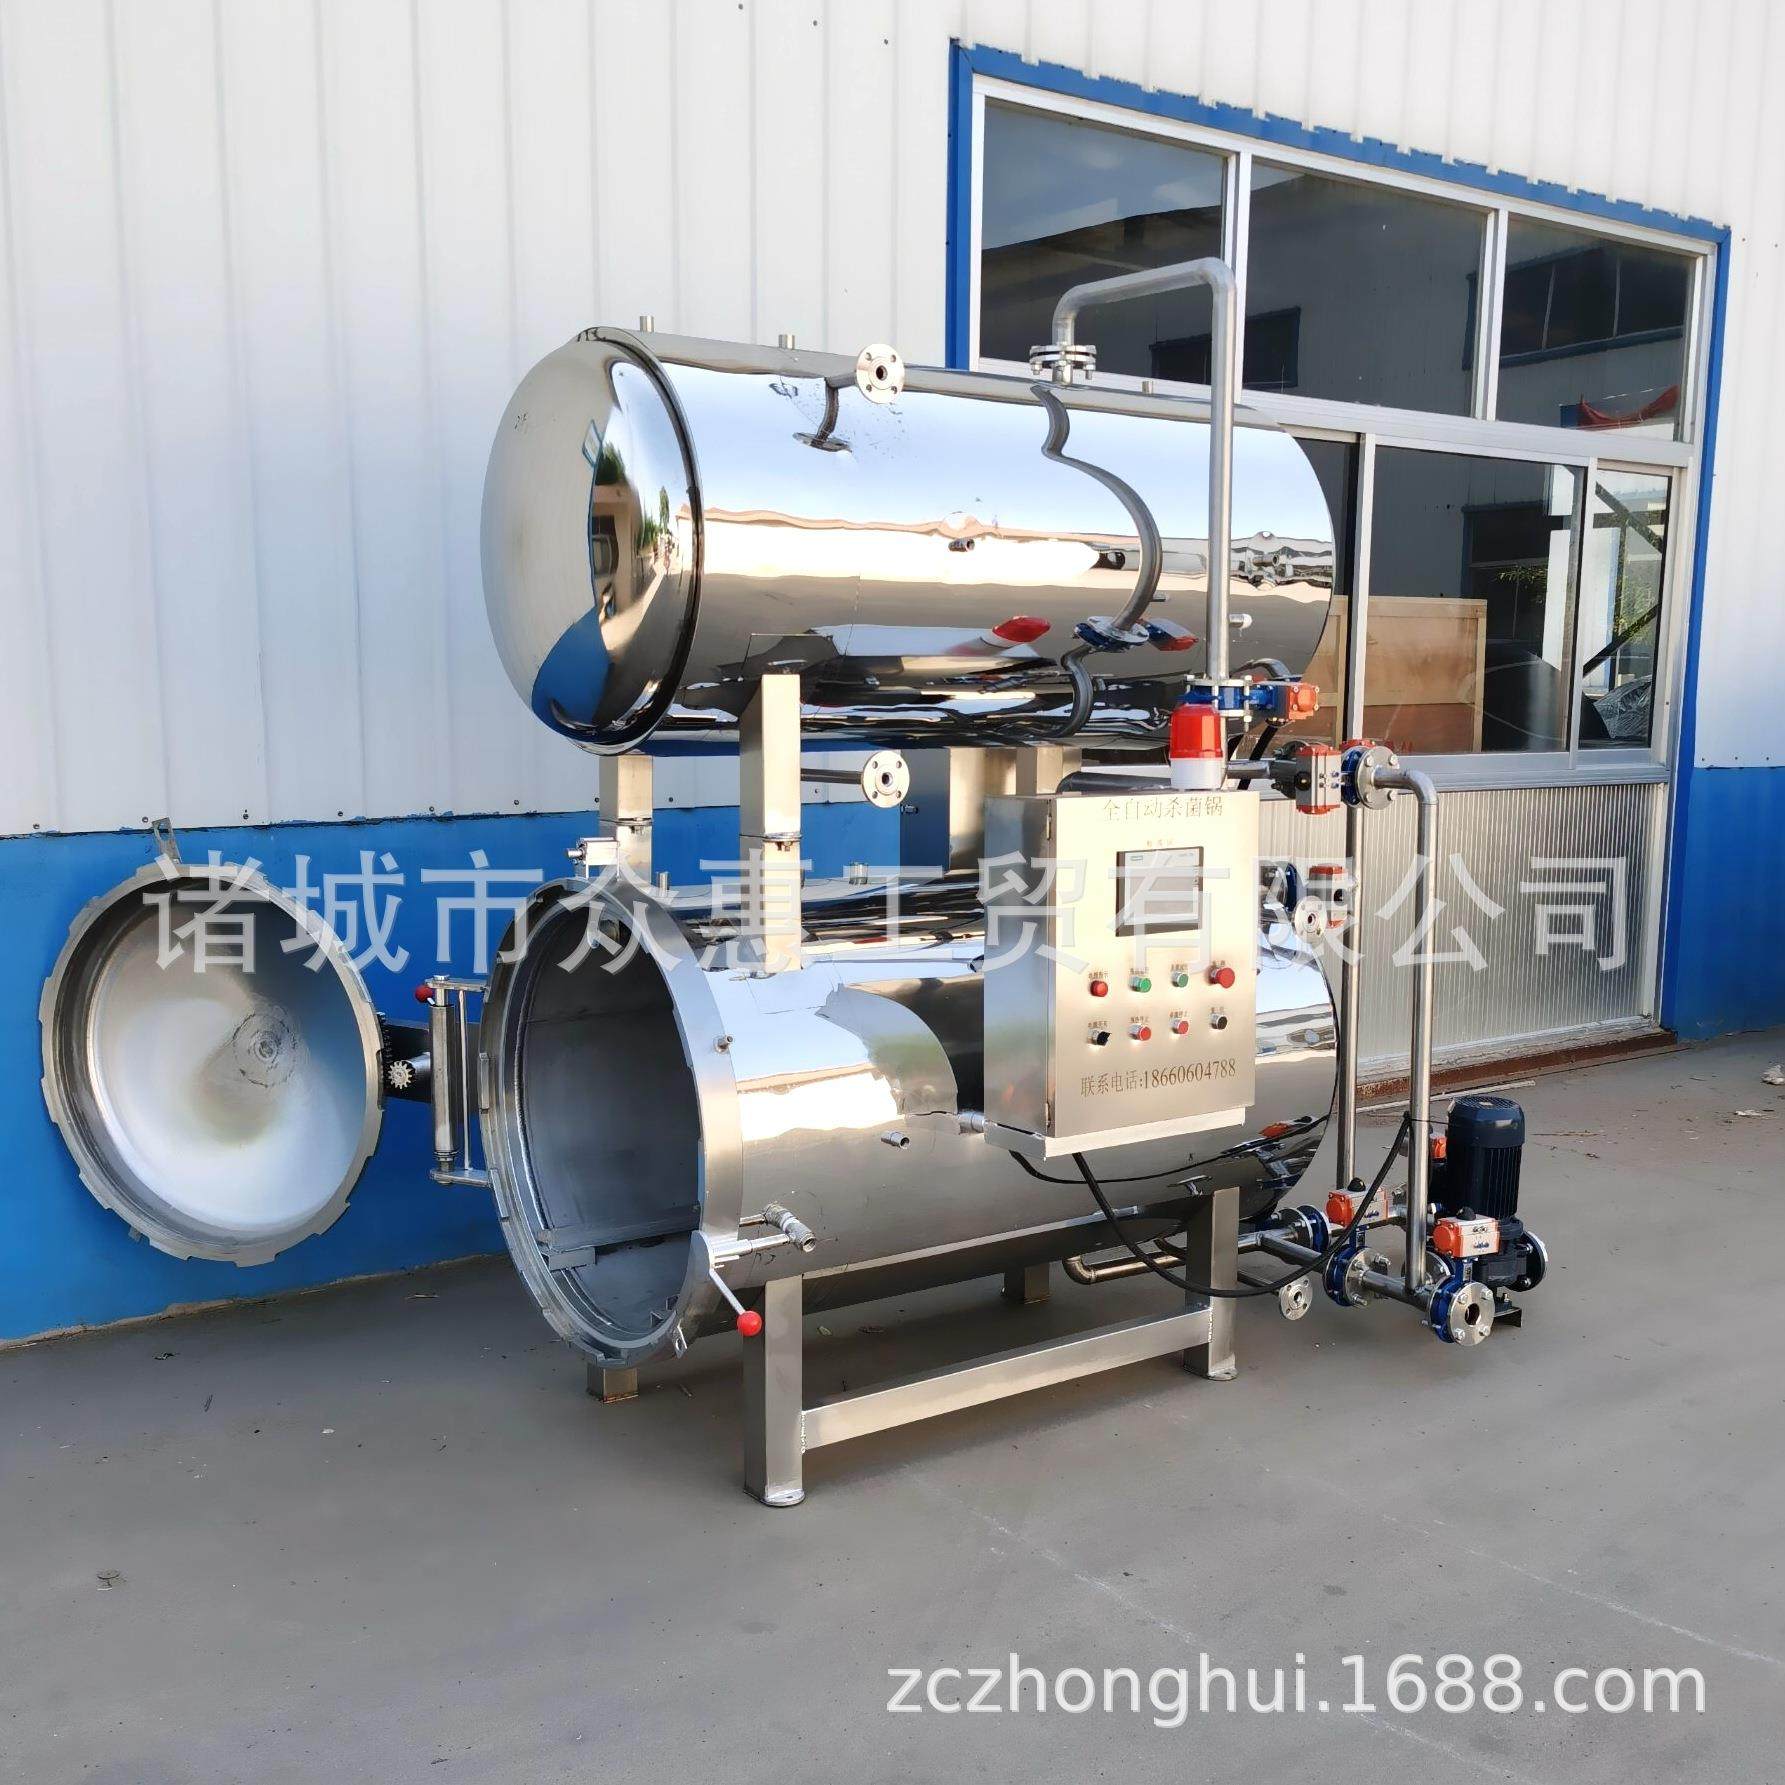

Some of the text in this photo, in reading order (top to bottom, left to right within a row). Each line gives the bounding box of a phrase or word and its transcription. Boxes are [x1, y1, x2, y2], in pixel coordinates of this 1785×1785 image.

[1103, 796, 1224, 821] 全自动杀菌锅
[1080, 1058, 1236, 1098] 联系电话:18660604788
